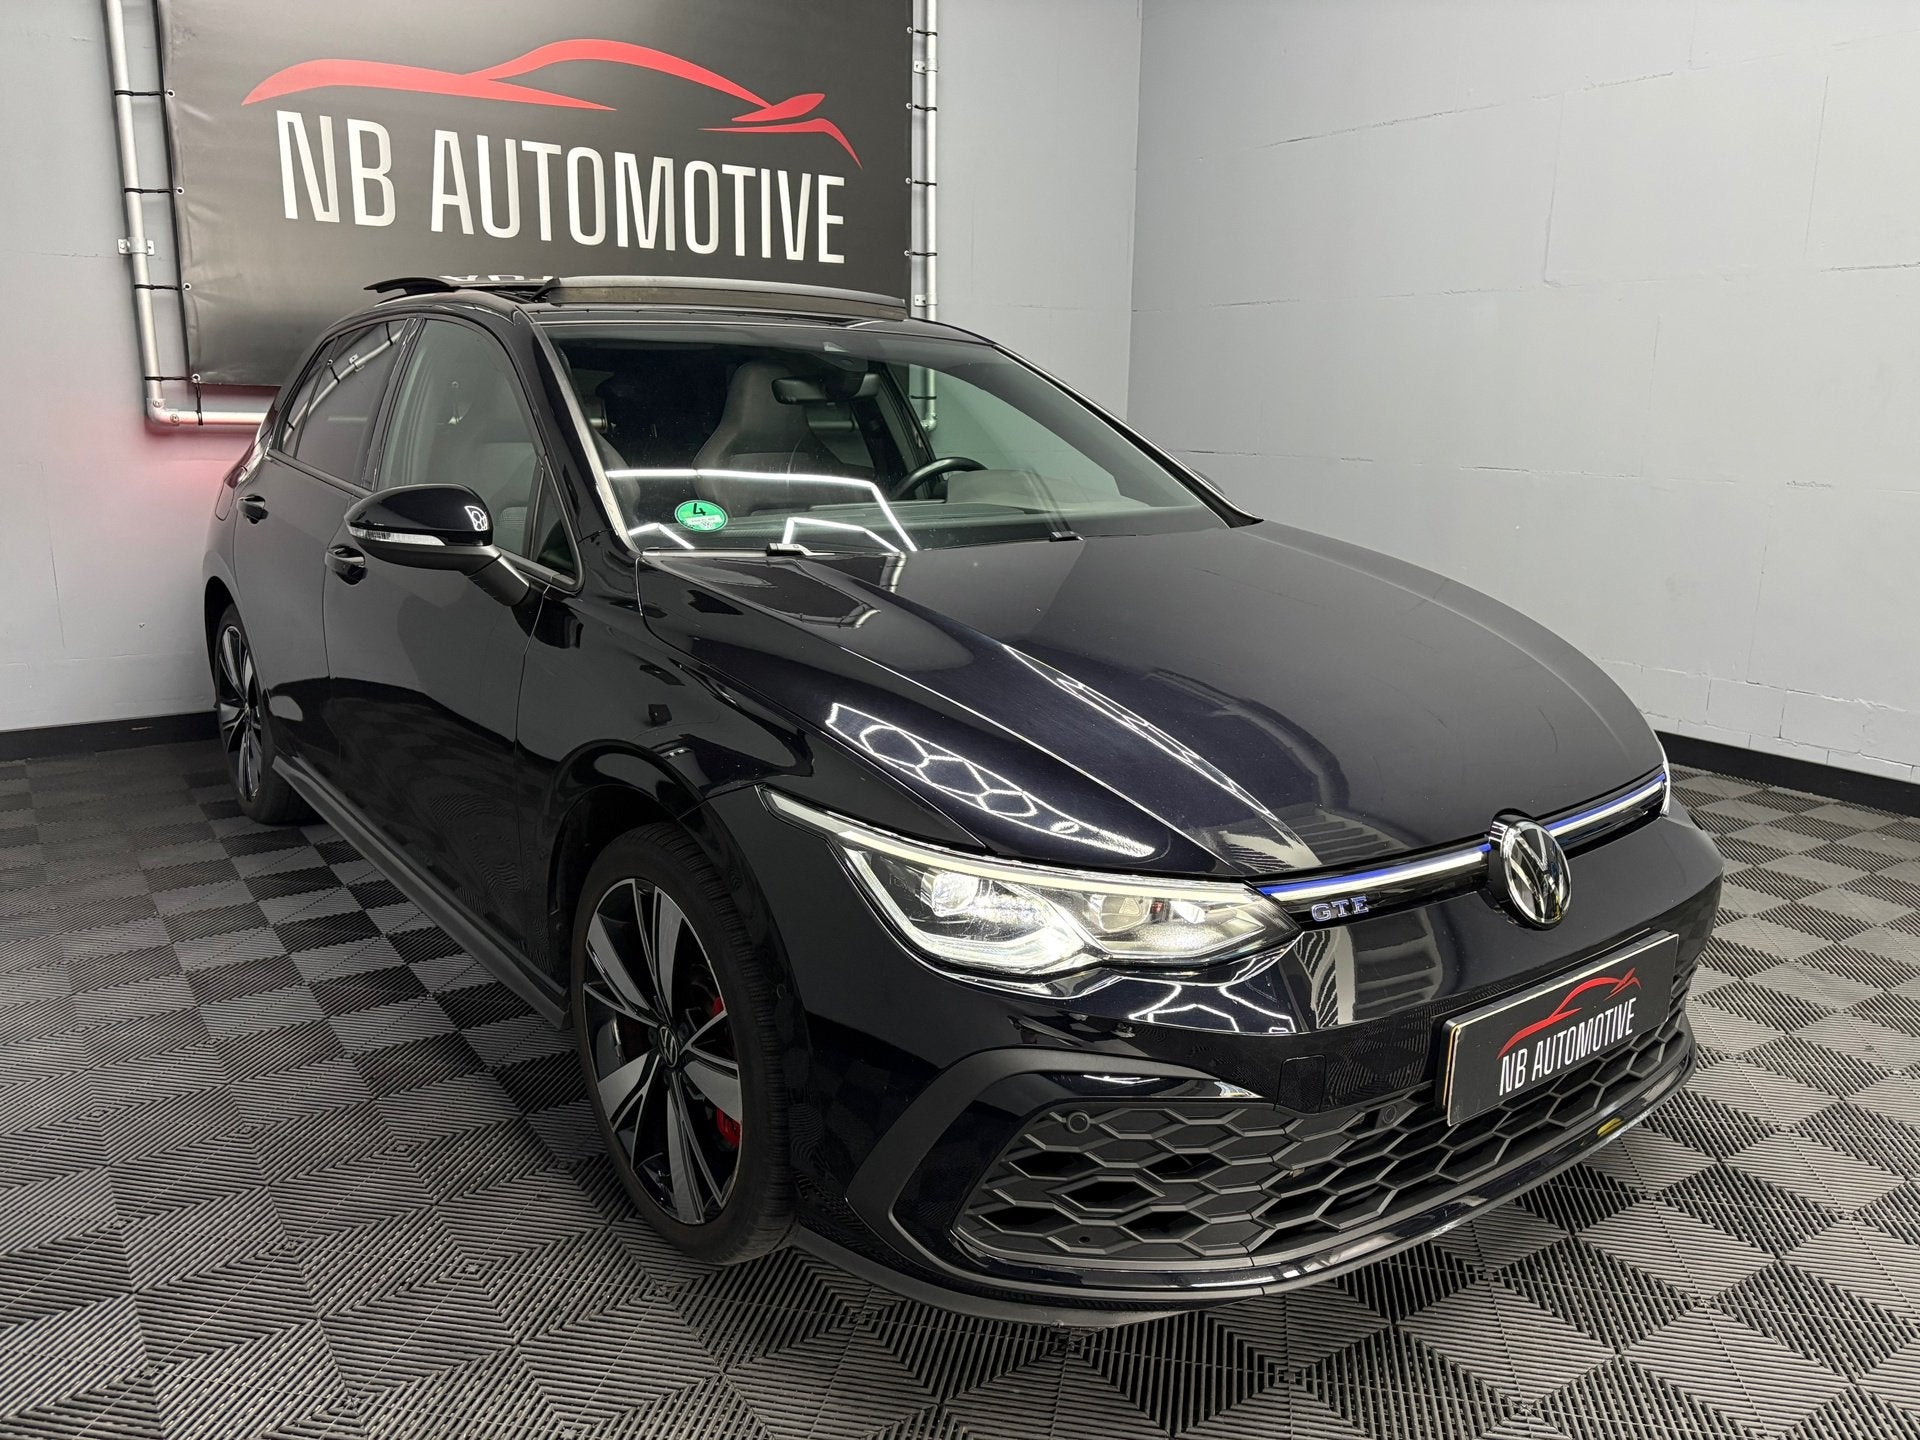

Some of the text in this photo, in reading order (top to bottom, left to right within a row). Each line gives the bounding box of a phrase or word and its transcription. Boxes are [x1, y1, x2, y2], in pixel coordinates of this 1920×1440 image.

[276, 109, 846, 265] NB AUTOMOTIVE
[692, 502, 706, 516] 4
[1311, 895, 1369, 922] GTE
[1499, 997, 1637, 1097] NB AUTOMOTIVE
